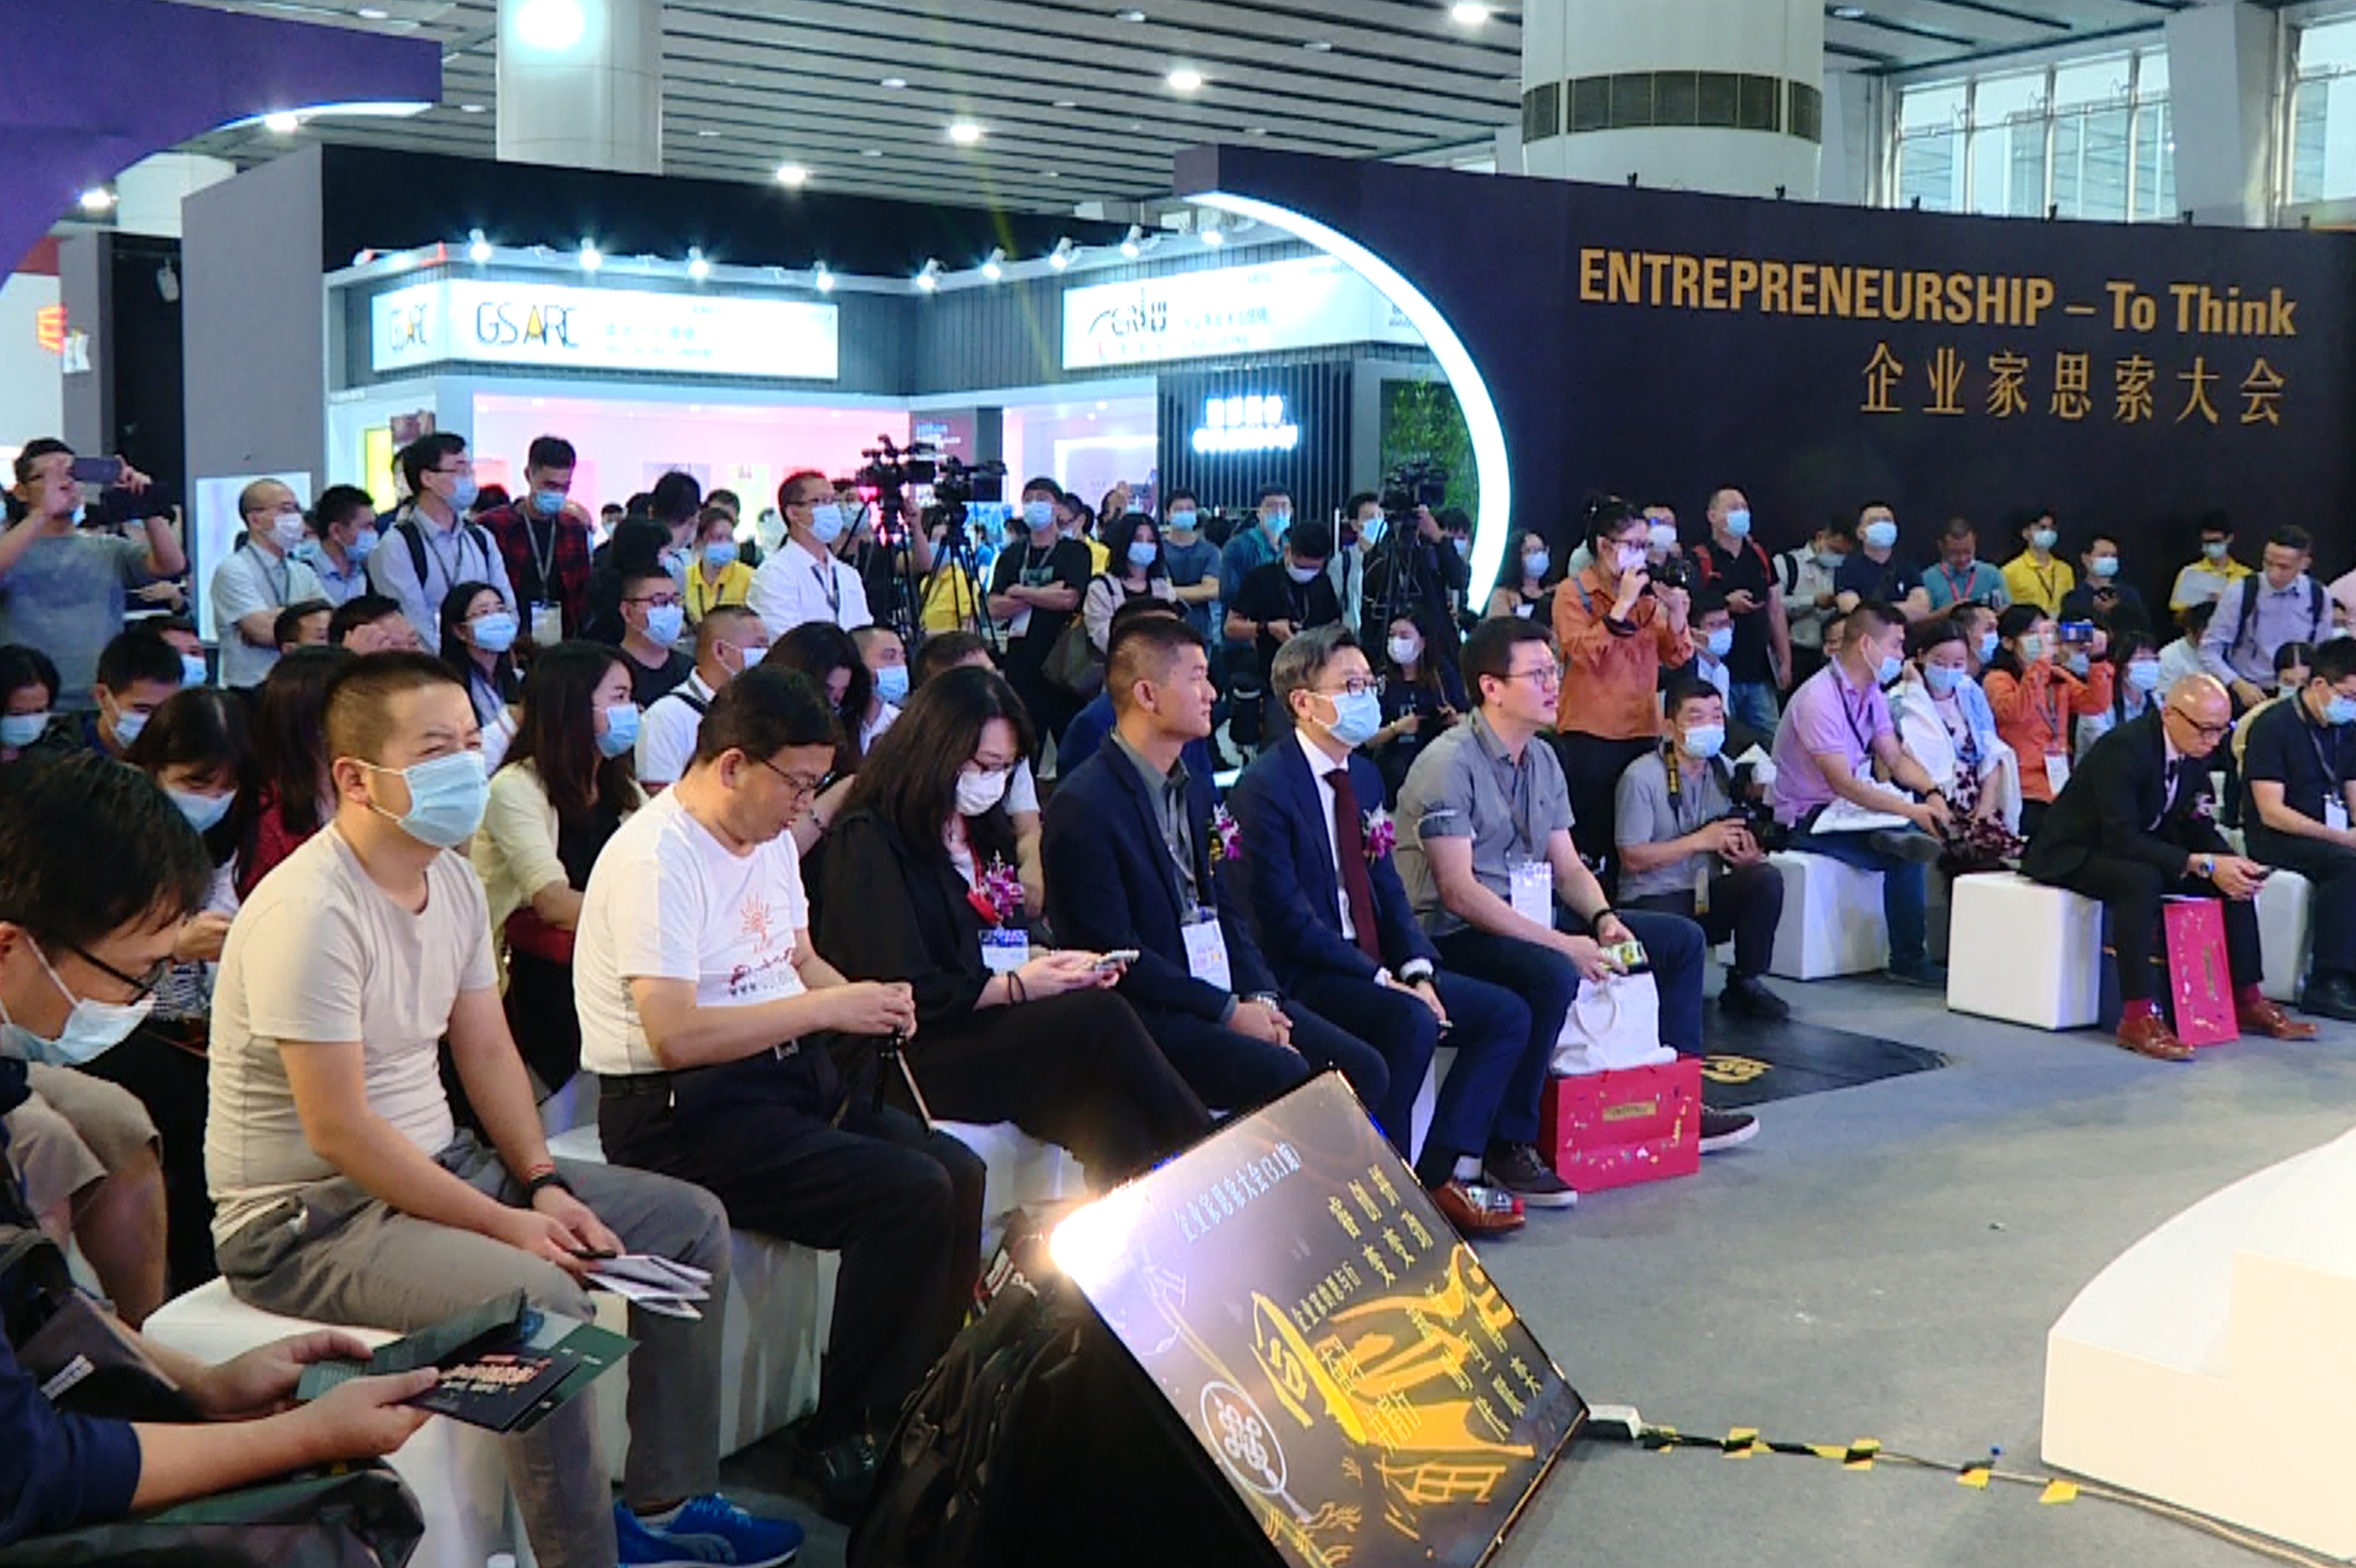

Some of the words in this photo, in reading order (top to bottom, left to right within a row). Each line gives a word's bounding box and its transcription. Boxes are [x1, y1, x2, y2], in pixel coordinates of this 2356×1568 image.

[1580, 248, 2054, 326] ENTREPRENEURSHIP
[2106, 281, 2156, 332] To
[2171, 283, 2296, 336] Think
[1860, 341, 2285, 425] 企业家思索大会
